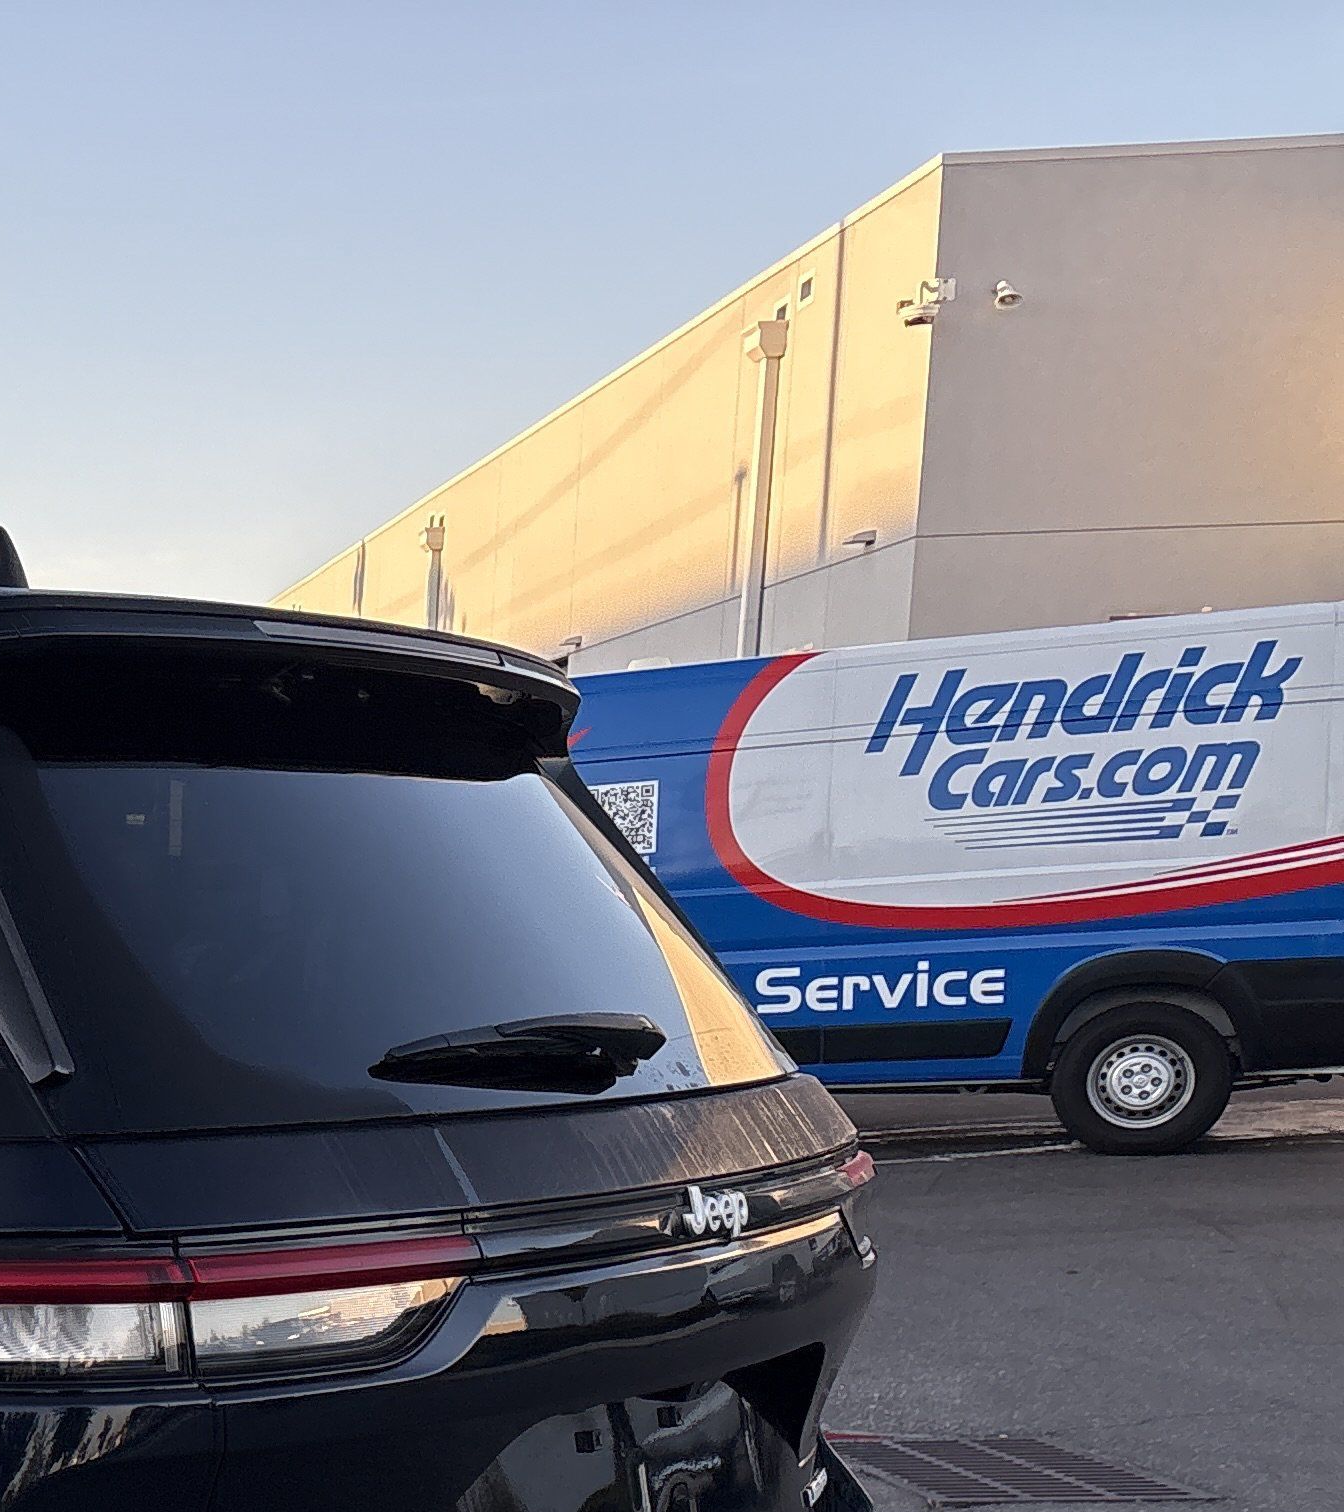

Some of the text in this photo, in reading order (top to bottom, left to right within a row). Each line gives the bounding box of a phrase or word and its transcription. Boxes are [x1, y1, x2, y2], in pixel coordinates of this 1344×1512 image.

[864, 639, 1303, 778] Hendrick
[927, 740, 1261, 811] Cars.com
[755, 960, 1007, 1015] Service
[682, 1185, 749, 1238] Jeep
